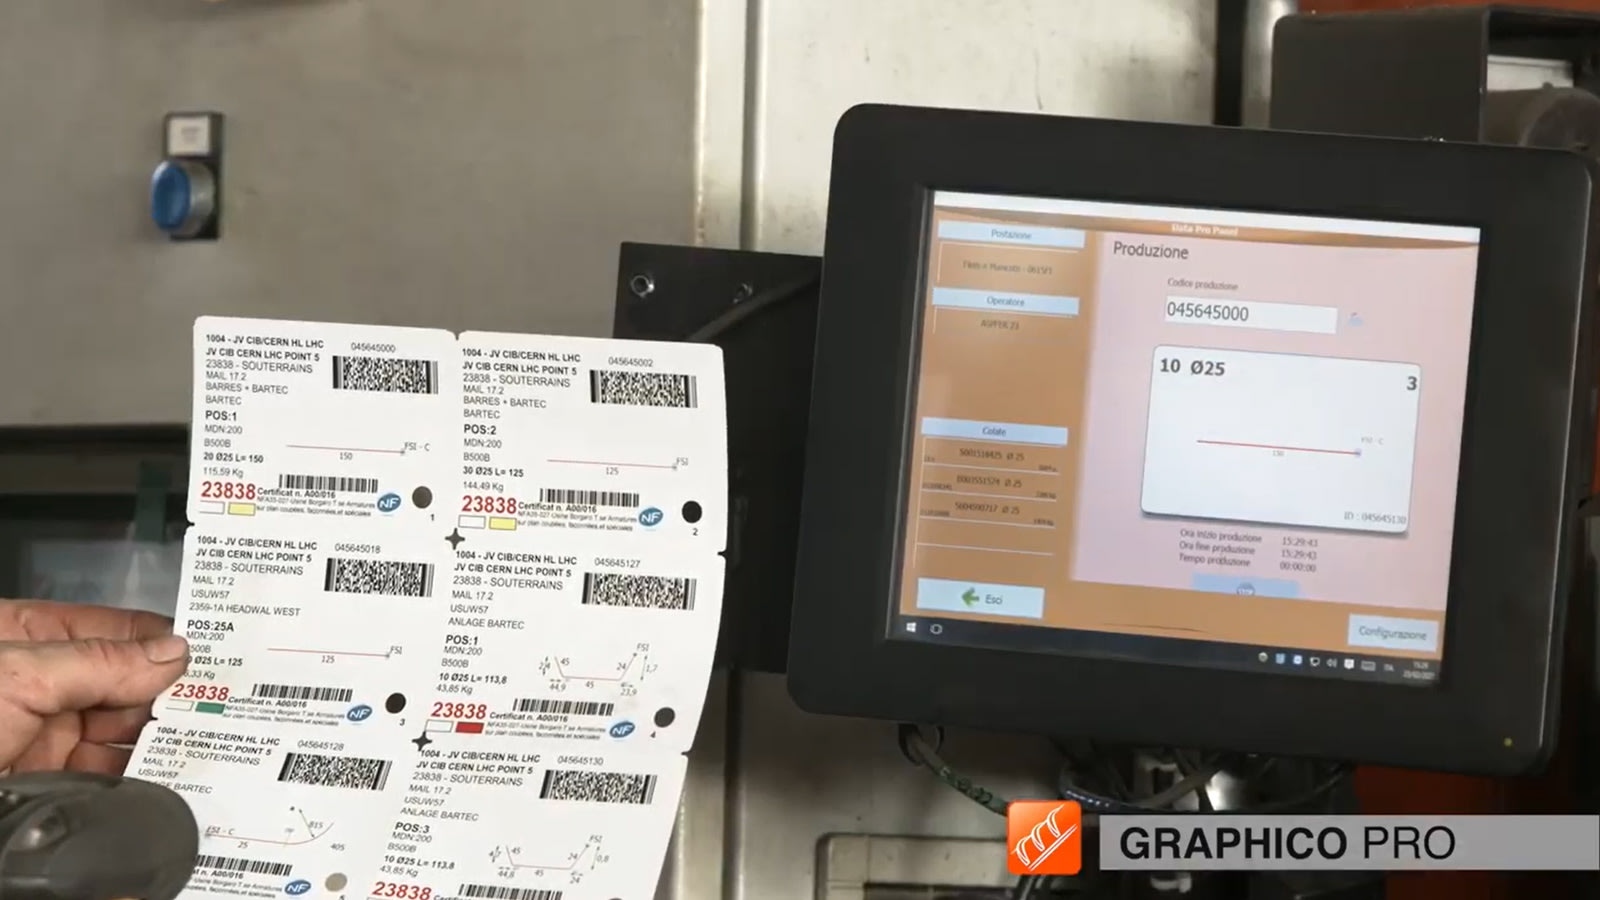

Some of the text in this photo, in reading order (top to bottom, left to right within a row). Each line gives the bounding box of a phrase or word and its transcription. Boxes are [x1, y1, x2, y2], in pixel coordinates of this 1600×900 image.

[991, 229, 1032, 239] Postazione
[1172, 224, 1193, 234] Data
[1195, 225, 1211, 235] Pro
[1113, 241, 1189, 259] Produzione
[1167, 278, 1238, 291] Codice produzione
[987, 296, 1025, 307] Operatore
[1167, 301, 1249, 321] 045645000
[206, 334, 324, 348] 1004 JV CIB/CERN HL LHC
[351, 343, 396, 352] 045645000
[206, 348, 320, 361] JV CIB CERN LHC POINT 5
[462, 348, 581, 362] 1004 JV CIB/CERN HL LHC
[206, 359, 313, 373] 23838 SOUTERRAINS
[608, 357, 653, 367] 045645002
[1160, 358, 1225, 376] 10 Ø25
[463, 362, 577, 375] JV CIB CERN LHC POINT 5
[206, 371, 227, 380] MAIL
[463, 374, 571, 387] 23838 SOUTERRAINS
[205, 383, 288, 394] BARRES BARTEC
[463, 385, 484, 393] MAIL
[1406, 376, 1417, 391] 3
[205, 396, 241, 405] BARTEC
[463, 397, 546, 408] BARRES BARTEC
[205, 410, 236, 421] POS:1
[464, 409, 500, 419] BARTEC
[464, 424, 497, 435] POS:2
[982, 427, 1006, 436] Colate
[249, 455, 264, 463] 150
[509, 469, 524, 477] 125
[201, 481, 256, 500] 23838
[257, 488, 336, 499] Certificat A00/016
[380, 499, 400, 508] NF
[462, 495, 517, 514] 23838
[518, 501, 597, 513] Certificat A00/016
[641, 513, 660, 523] NF
[1344, 511, 1354, 520] ID
[693, 528, 698, 536] 2
[1180, 529, 1262, 543] Ora inizio produzione
[198, 536, 317, 550] 1004 JV CIB/CERN HL LHC
[1282, 537, 1318, 547] 15:29:43
[335, 543, 381, 553] 045645018
[1179, 541, 1255, 556] Ora fine produzione
[196, 549, 312, 562] JV CIB CERN LHC POINT 5
[456, 550, 577, 565] 1004 JV CIB/CERN HL LHC
[1179, 553, 1250, 567] Tempo produzione
[1281, 549, 1317, 560] 15:29:43
[195, 561, 304, 575] 23838 SOUTERRAINS
[595, 557, 641, 568] 045645127
[1280, 561, 1316, 572] 00:00:00
[454, 563, 572, 577] JV CIB CERN LHC POINT 5
[193, 575, 214, 584] MAIL
[453, 576, 563, 591] 23838 SOUTERRAINS
[192, 589, 230, 599] USUW57
[452, 590, 474, 599] MAIL
[985, 594, 1003, 605] Esci
[226, 604, 301, 616] HEADWAL WEST
[187, 620, 234, 632] POS:25A
[448, 617, 525, 630] ANLAGE BARTEC
[1359, 625, 1427, 641] Configurazione
[446, 635, 478, 645] POS:1
[228, 658, 243, 666] 125
[321, 655, 335, 664] 125
[171, 683, 229, 701] 23838
[228, 696, 307, 708] Certificat A00/016
[349, 709, 370, 720] NF
[431, 702, 487, 719] 23838
[399, 718, 405, 726] 3
[490, 712, 568, 723] Certificat A00/016
[612, 724, 633, 735] NF
[650, 731, 656, 739] 4
[157, 727, 280, 746] 1004 JV CIB/CERN HL LHC
[298, 740, 345, 751] 045645128
[185, 749, 260, 766] SOUTERRAINS
[448, 751, 540, 763] JV CIB/CERN HL LHC
[558, 755, 604, 766] 045645130
[450, 774, 523, 786] SOUTERRAINS
[174, 783, 213, 794] BARTEC
[400, 807, 439, 819] ANLAGE
[395, 822, 430, 834] POS:3
[287, 883, 308, 894] NF
